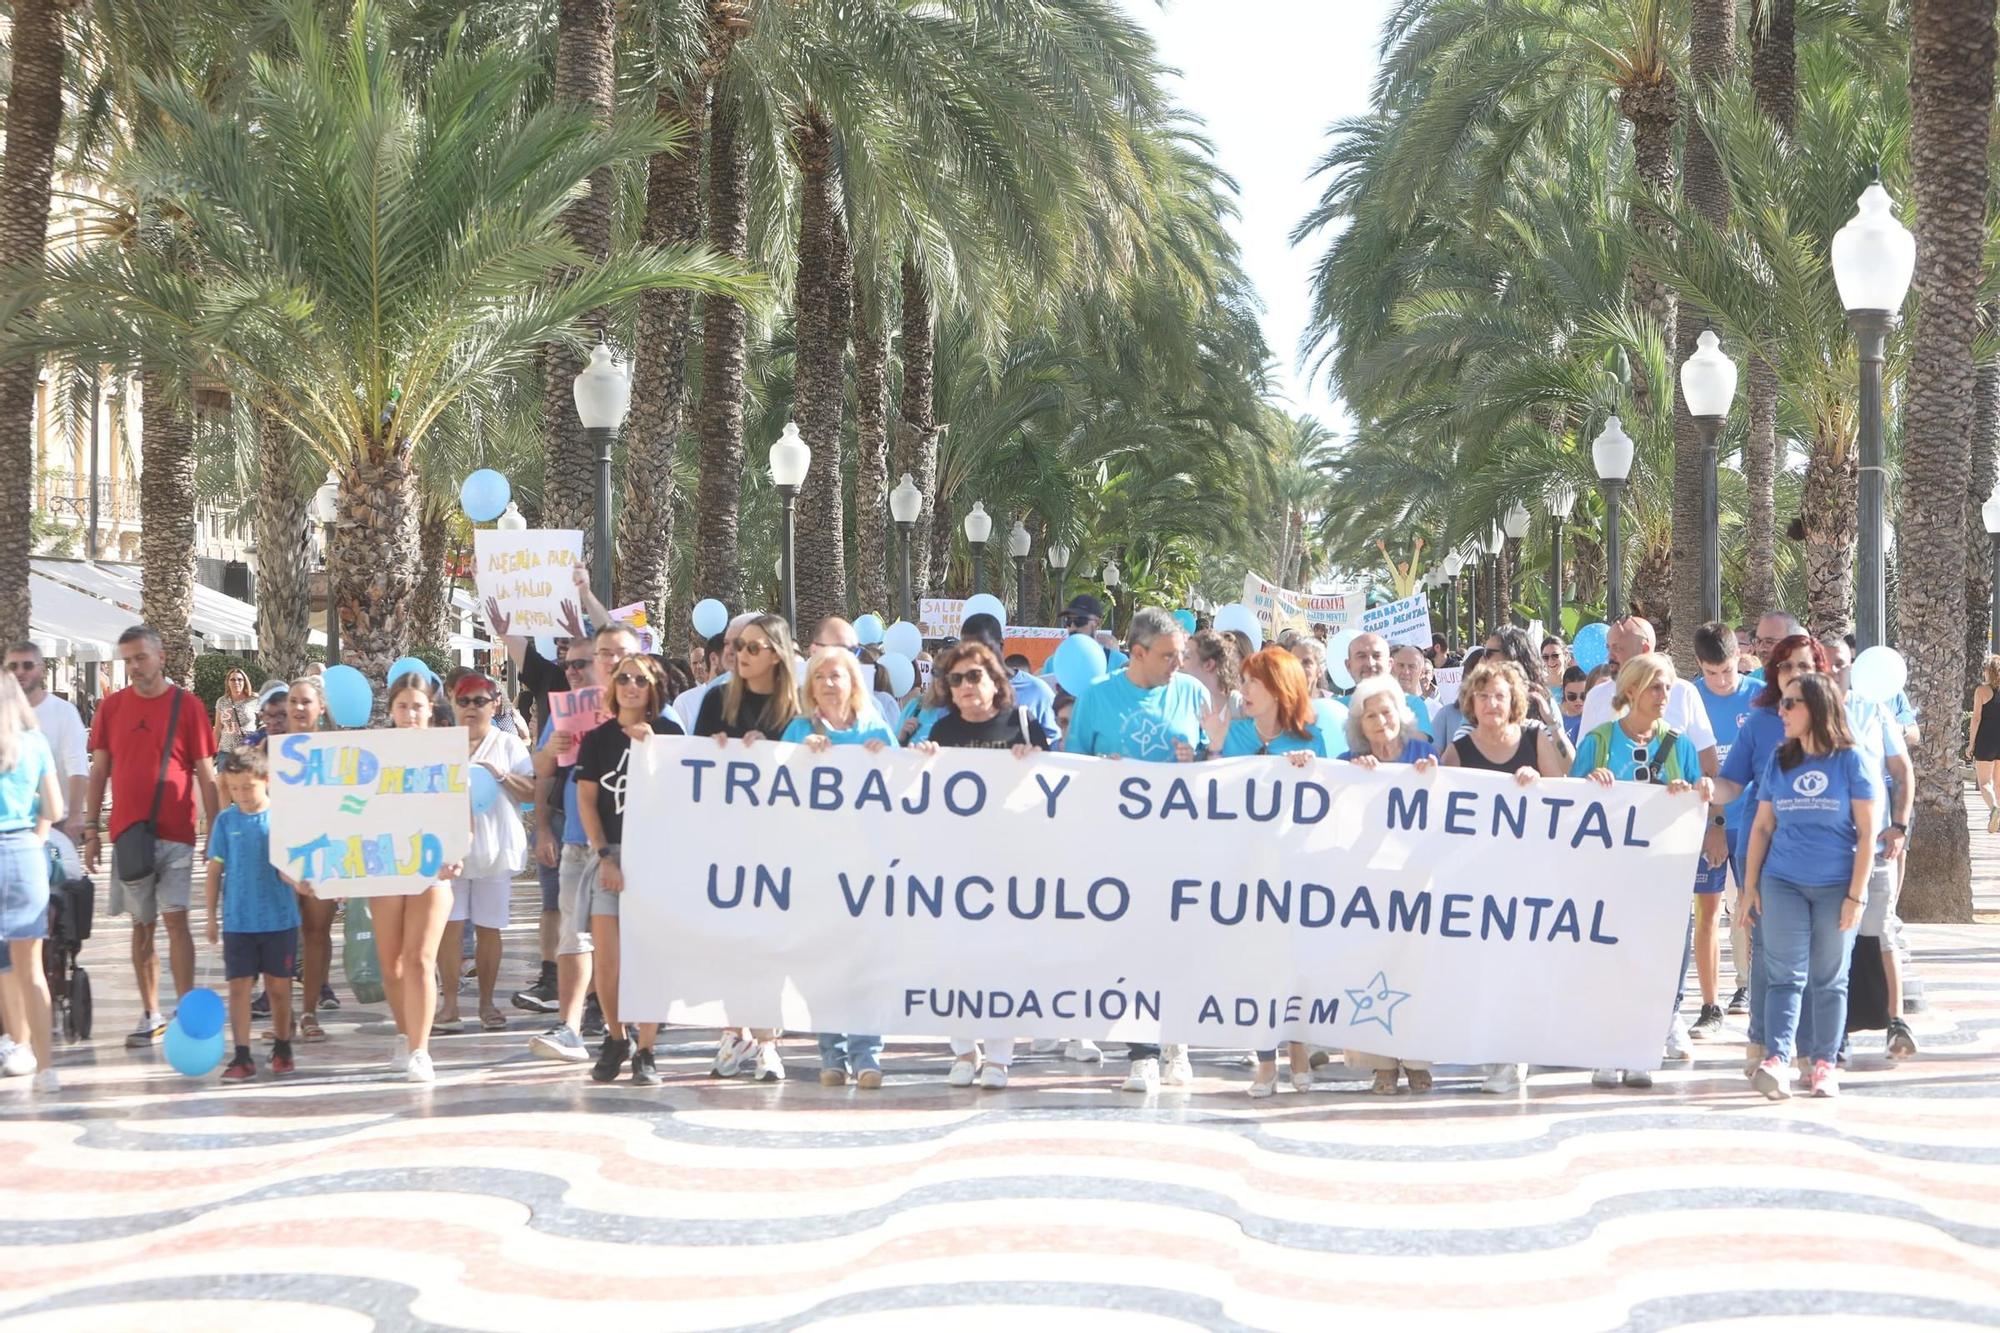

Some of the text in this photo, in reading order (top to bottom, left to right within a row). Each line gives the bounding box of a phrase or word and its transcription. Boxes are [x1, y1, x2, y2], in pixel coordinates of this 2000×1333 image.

[496, 578, 552, 600] LA SALUD
[1363, 596, 1421, 623] TRABAJO Y
[1363, 606, 1427, 633] SALUD MENTAL
[277, 734, 466, 795] SALUD MENTAL
[681, 758, 1652, 849] TRABAJO Y SALUD MENTAL
[287, 829, 443, 884] TRABAJO
[706, 858, 1620, 946] UN VÍNCULO FUNDAMENTAL
[904, 976, 1341, 1028] FUNDACIÓN ADIEM
